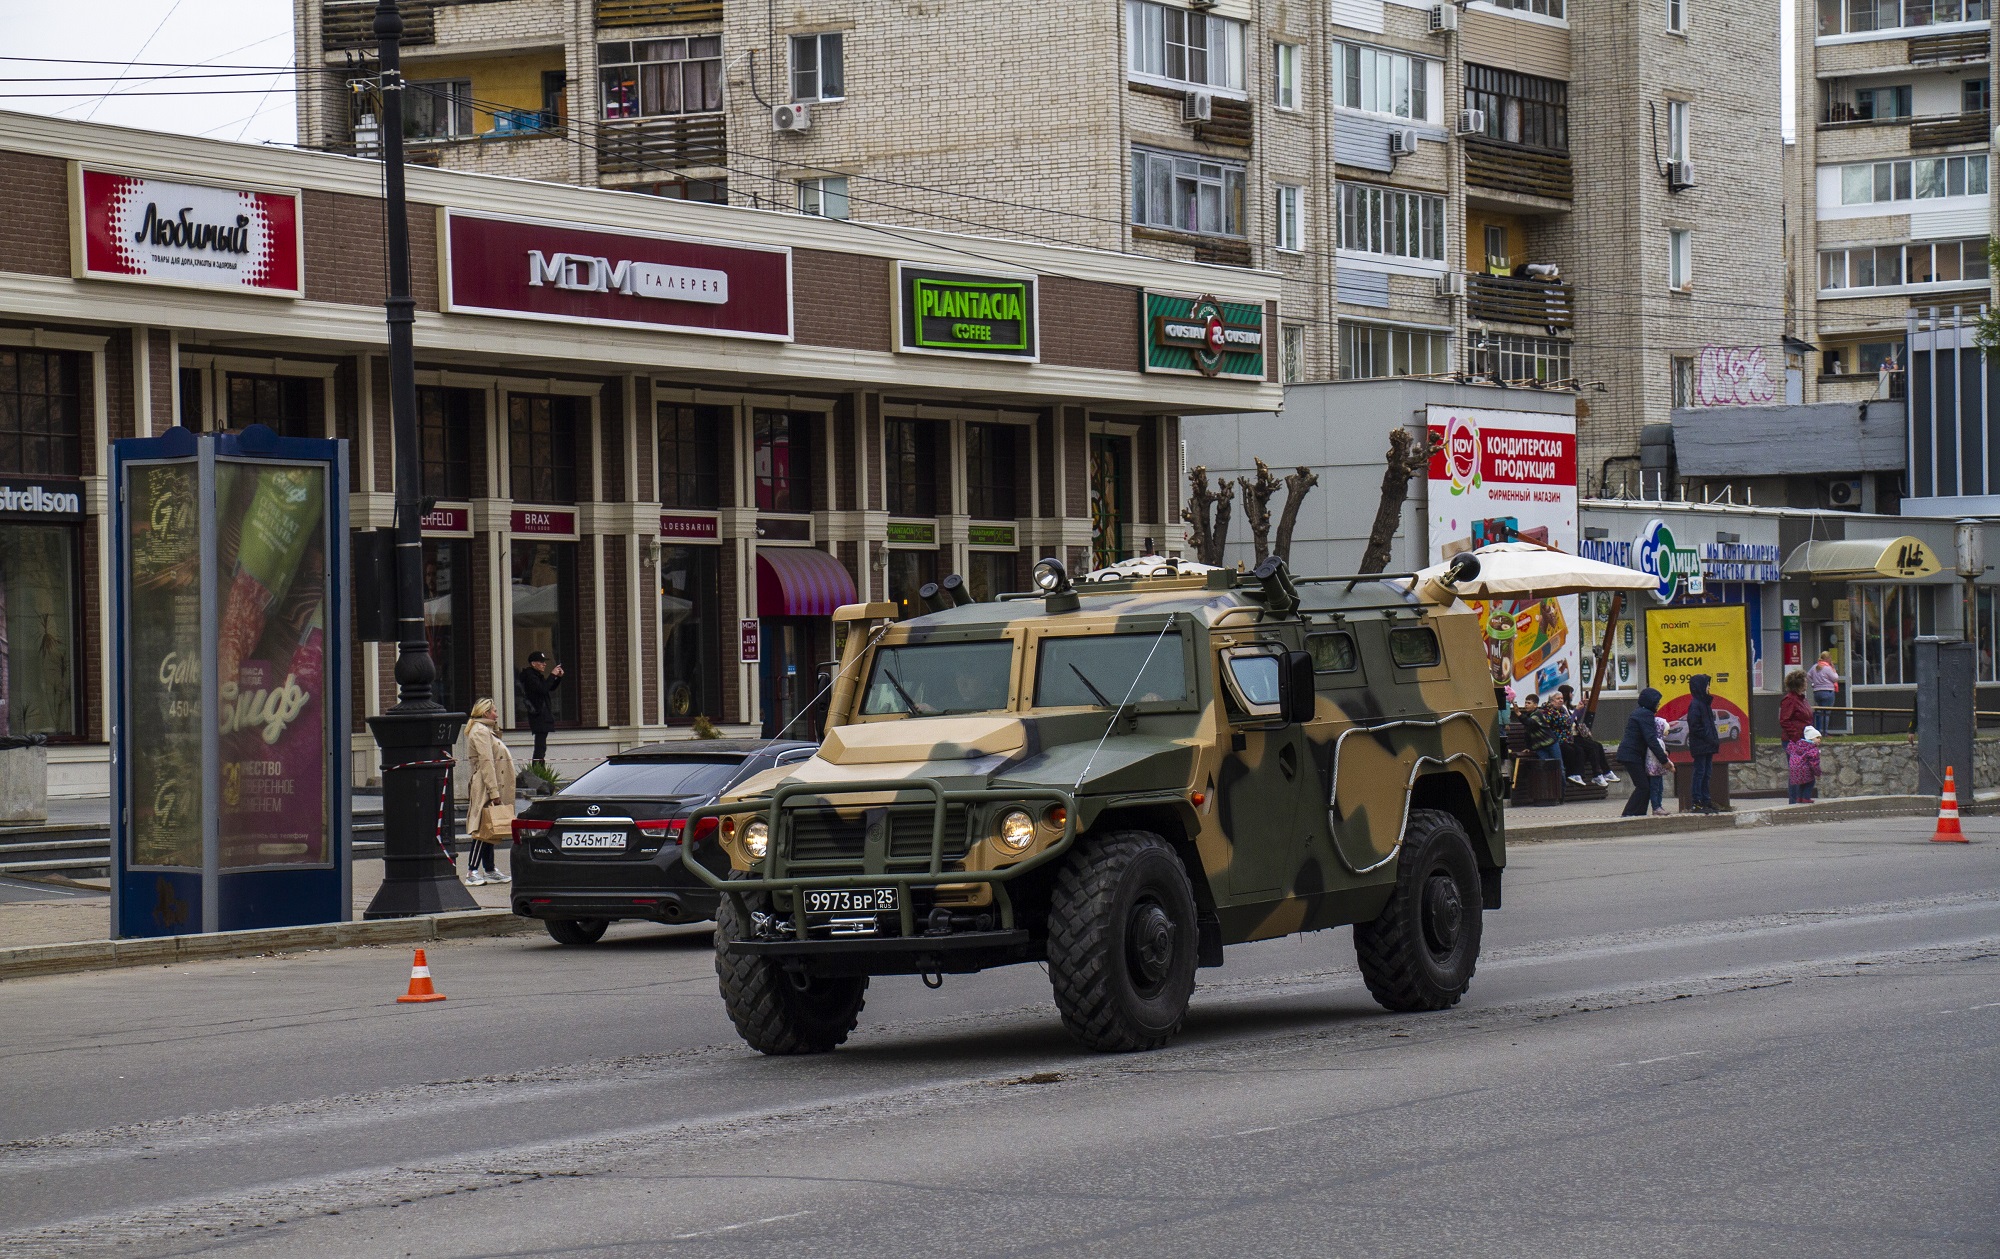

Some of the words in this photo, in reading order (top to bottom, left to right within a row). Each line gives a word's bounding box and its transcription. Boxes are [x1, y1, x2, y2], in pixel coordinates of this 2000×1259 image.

[135, 202, 250, 254] Любимый
[152, 254, 170, 263] ТОВАРЫ
[528, 250, 633, 295] MDM
[646, 273, 718, 293] ГАЛЕРЕЯ
[922, 289, 1021, 320] PLANTACIA
[952, 323, 991, 341] COFFEE
[1165, 324, 1206, 340] GUSTAV
[1212, 326, 1225, 344] &
[1453, 438, 1473, 453] KDV
[1487, 436, 1562, 458] КОНДИТЕРСКАЯ
[1495, 459, 1555, 481] ПРОДУКЦИЯ
[1488, 488, 1531, 501] ФИРМЕННЫЙ
[1533, 491, 1560, 503] МАГАЗИН
[525, 513, 549, 525] BRAX
[1661, 621, 1689, 629] maxim
[1662, 641, 1716, 654] Закажи
[1662, 657, 1702, 667] такси
[611, 833, 623, 843] 27
[877, 889, 893, 904] 25
